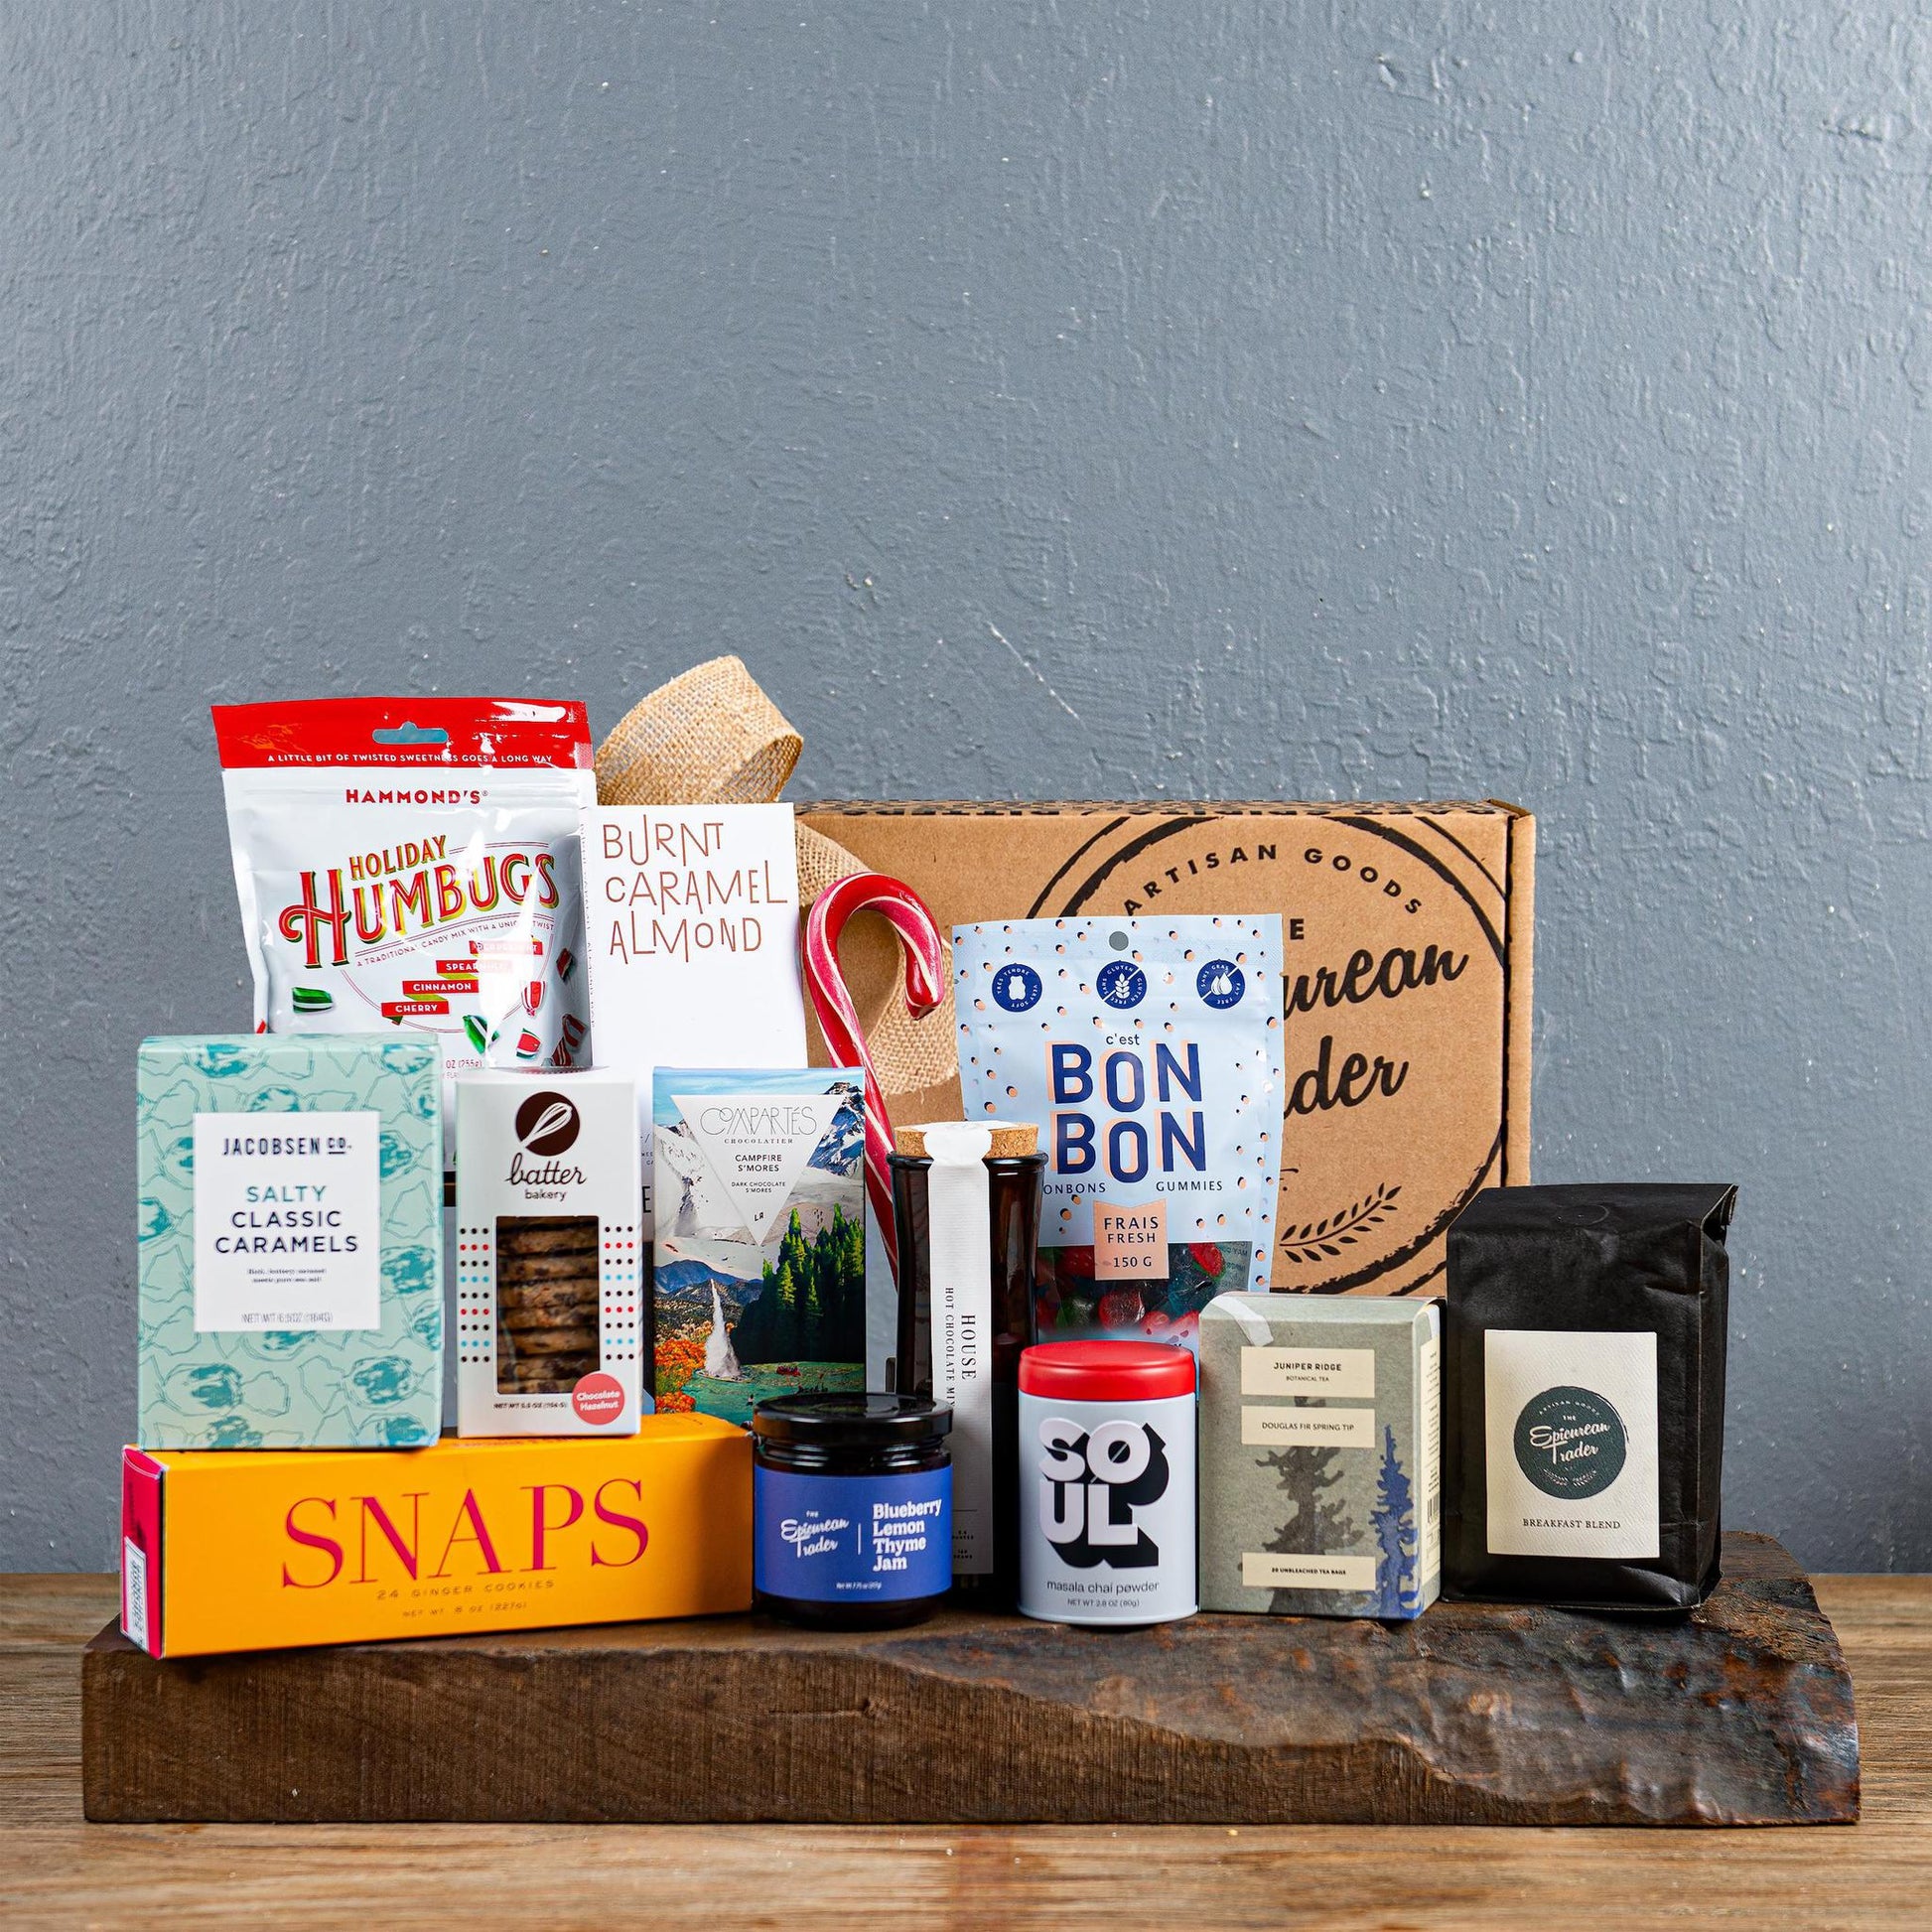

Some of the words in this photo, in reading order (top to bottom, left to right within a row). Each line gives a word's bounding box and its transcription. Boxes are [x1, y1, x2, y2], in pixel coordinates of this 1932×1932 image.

[345, 789, 481, 804] HAMMOND'S
[603, 814, 724, 867] BURNT
[348, 834, 448, 882] HOLIDAY
[606, 860, 787, 914] CARAMEL
[1123, 844, 1278, 916] ARTISAN
[1305, 848, 1423, 915] GOODS
[278, 853, 561, 968] HUMBUGS
[422, 936, 449, 948] CANDY
[451, 930, 467, 941] MIX
[468, 925, 489, 935] WITH
[532, 920, 554, 931] TWIST
[610, 910, 761, 965] ALMOND
[413, 983, 472, 992] CINNAMON
[395, 1004, 438, 1013] CHERRY
[1105, 1034, 1140, 1046] c'est
[1048, 1042, 1202, 1113] BON
[222, 1138, 321, 1155] JACOBSEN
[328, 1137, 352, 1153] CO.
[1053, 1111, 1207, 1183] BON
[735, 1154, 782, 1163] CAMPFIRE
[504, 1152, 588, 1185] batter
[738, 1164, 779, 1173] S'MORES
[246, 1185, 327, 1203] SALTY
[1156, 1180, 1223, 1192] GUMMIES
[524, 1189, 568, 1202] bakery
[231, 1210, 342, 1228] CLASSIC
[754, 1211, 764, 1222] LA
[1104, 1216, 1160, 1230] FRAIS
[214, 1235, 358, 1254] CARAMELS
[1107, 1233, 1156, 1244] FRESH
[1113, 1256, 1138, 1268] 150
[1143, 1256, 1153, 1267] G
[945, 1287, 954, 1310] HOT
[945, 1314, 955, 1382] CHOCOLATE
[960, 1314, 977, 1380] HOUSE
[1273, 1362, 1312, 1371] JUNIPER
[576, 1390, 621, 1401] Chocolate
[580, 1400, 620, 1411] Hazelnut
[1262, 1422, 1299, 1431] DOUGLAS
[1529, 1423, 1611, 1448] Epicurean
[1542, 1441, 1599, 1465] Trader
[873, 1498, 943, 1520] Blueberry
[780, 1517, 850, 1541] Epicurean
[873, 1520, 926, 1538] Lemon
[1522, 1518, 1583, 1529] BREAKFAST
[1586, 1519, 1621, 1529] BLEND
[281, 1477, 649, 1589] SNAPS
[789, 1536, 839, 1559] Trader
[873, 1537, 927, 1558] Thyme
[873, 1556, 907, 1573] Jam
[412, 1585, 474, 1598] GINGER
[484, 1580, 555, 1593] COOKIES
[1046, 1581, 1085, 1593] masala
[1087, 1582, 1113, 1593] chai
[1116, 1581, 1160, 1596] powder
